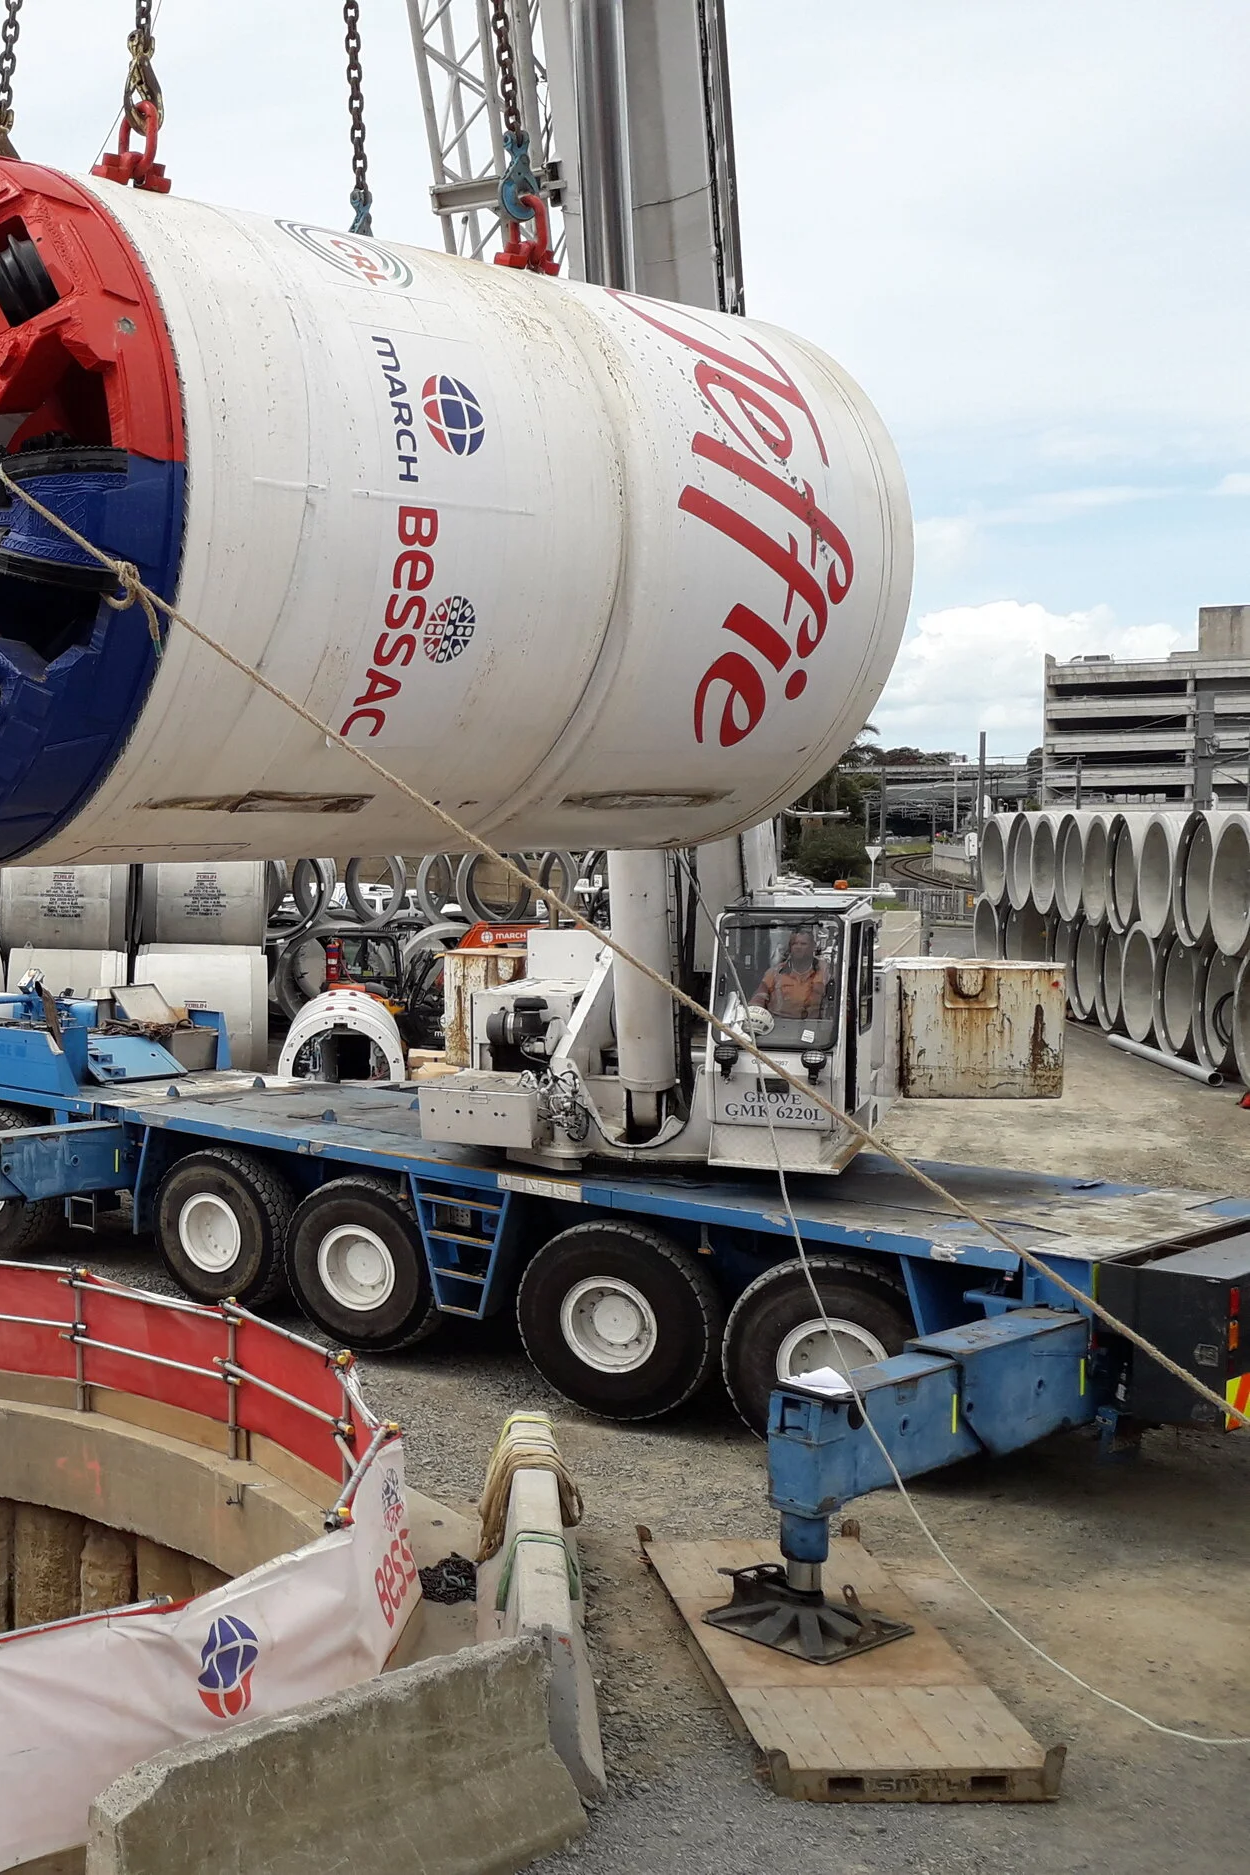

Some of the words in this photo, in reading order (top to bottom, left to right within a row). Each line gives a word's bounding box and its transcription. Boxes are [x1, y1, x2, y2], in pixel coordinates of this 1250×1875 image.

[330, 239, 388, 287] CRL
[371, 335, 419, 482] MARCH
[744, 1091, 802, 1105] GROVE
[776, 1105, 826, 1121] 6220L
